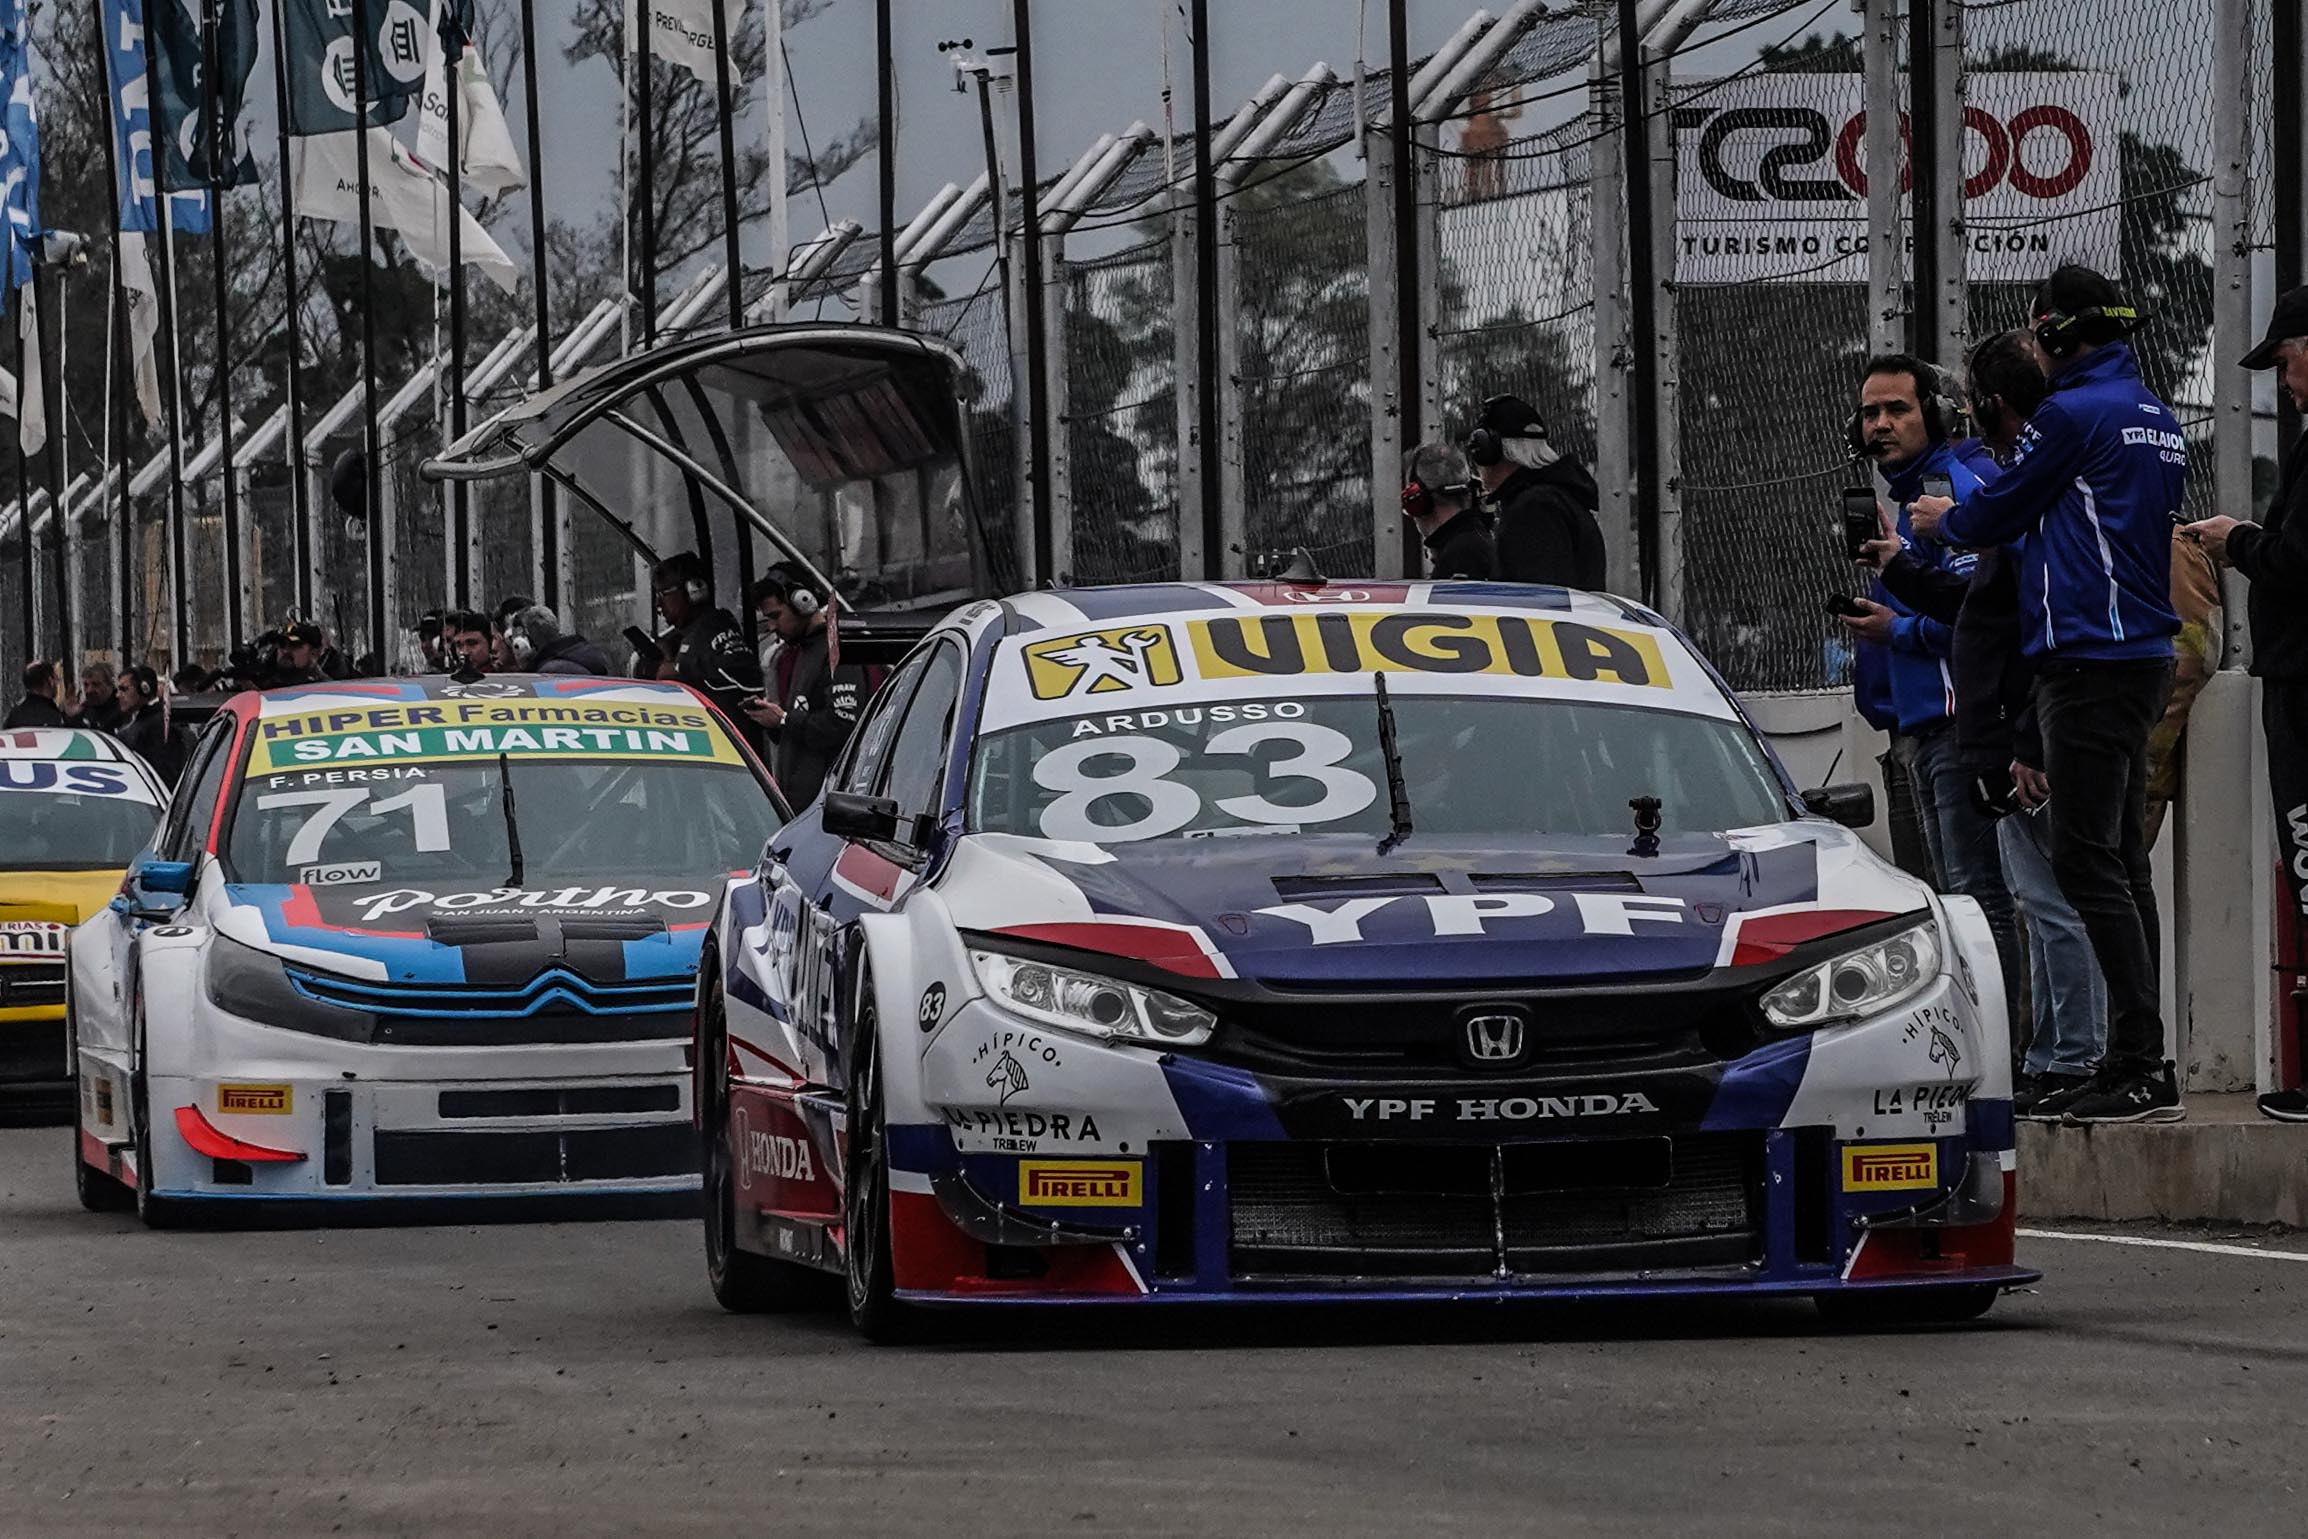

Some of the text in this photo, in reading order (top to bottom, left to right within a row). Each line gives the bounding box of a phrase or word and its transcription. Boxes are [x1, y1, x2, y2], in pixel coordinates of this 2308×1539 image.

[1682, 236, 1820, 255] TURISMO
[262, 704, 708, 738] HIPER Farmacias
[1072, 702, 1305, 737] ARDUSSO
[294, 727, 690, 760] SAN MARTIN
[270, 767, 427, 789] F. PERSIA
[1033, 722, 1377, 843] 83
[257, 783, 450, 867] 71
[302, 867, 378, 884] flow
[432, 908, 646, 917] SAN JUAN ARGENTINA
[1250, 893, 1687, 946] YPF
[919, 992, 945, 1021] 83
[223, 1089, 284, 1108] PIRELLI
[1343, 1092, 1660, 1121] YPF HONDA
[1874, 1089, 1903, 1115] LA
[975, 1111, 1101, 1141] PIEDRA
[750, 1130, 816, 1182] HONDA
[1852, 1153, 1931, 1182] PIRELLI
[1029, 1169, 1130, 1197] PIRELLI
